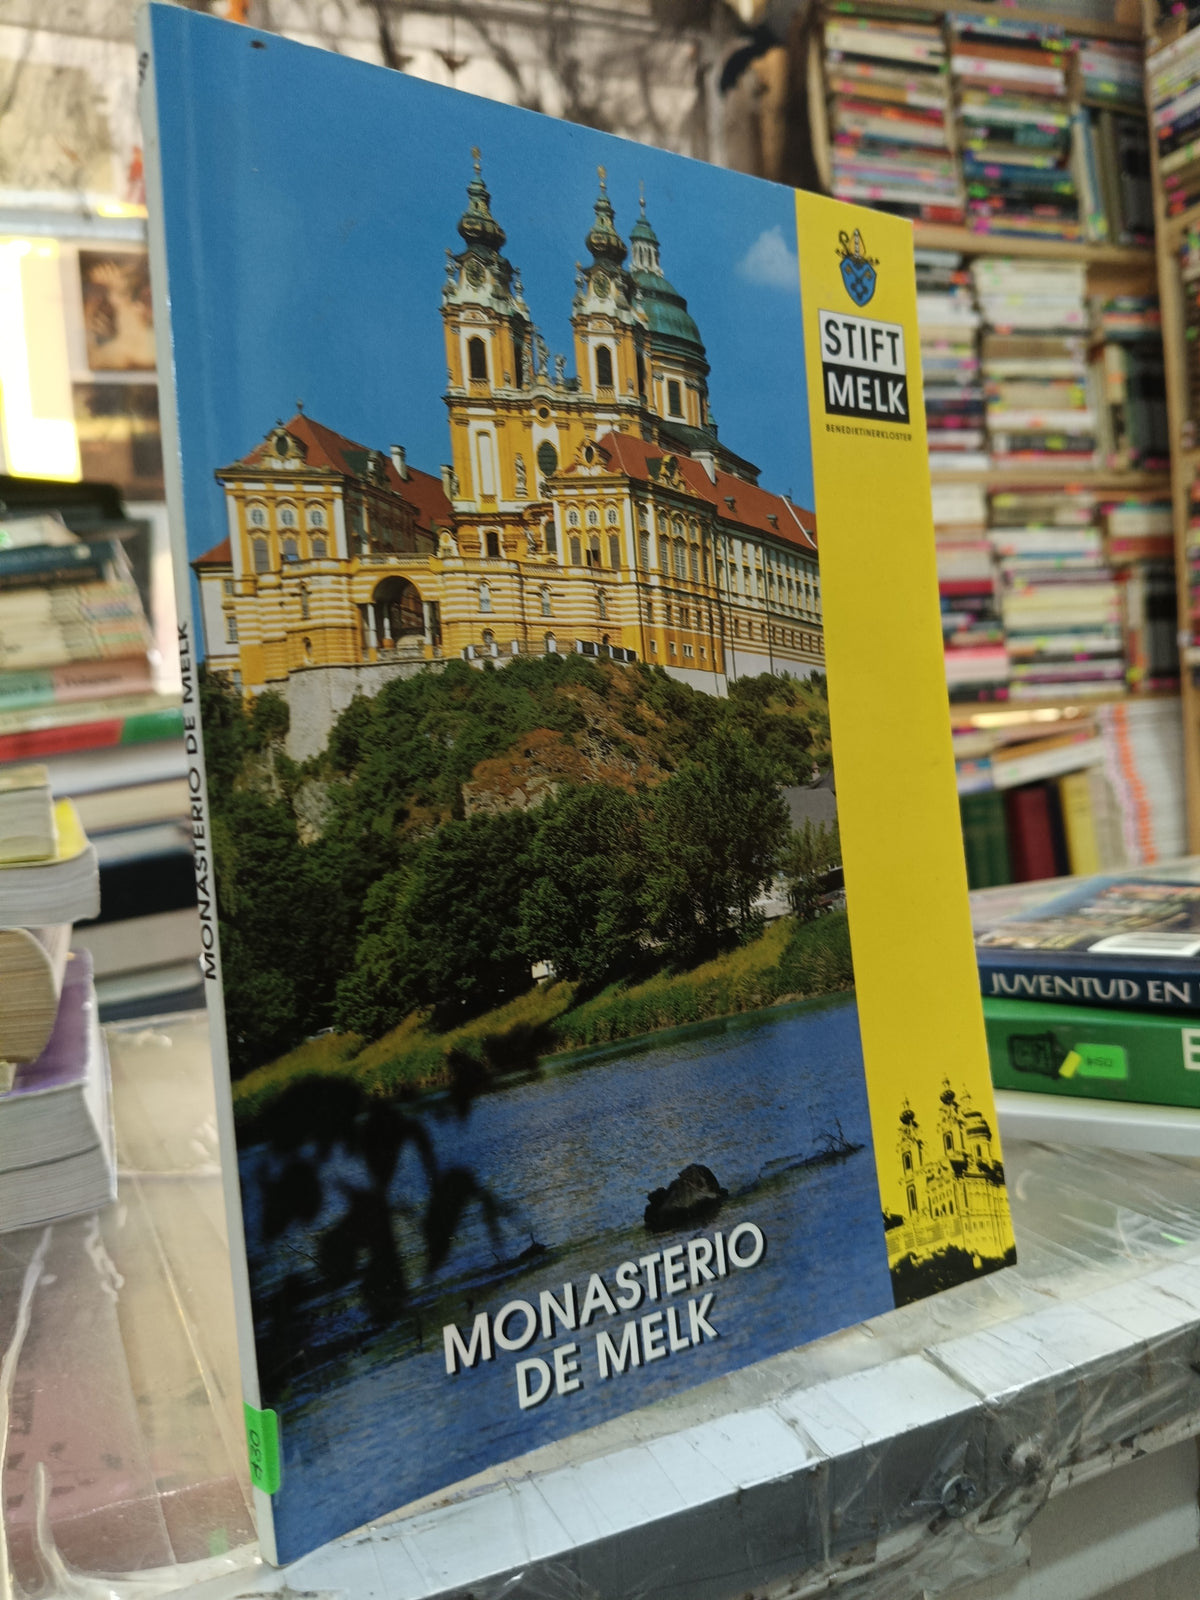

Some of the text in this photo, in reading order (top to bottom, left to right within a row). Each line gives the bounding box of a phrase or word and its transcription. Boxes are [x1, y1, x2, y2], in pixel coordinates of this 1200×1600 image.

[824, 319, 899, 366] STIFT
[827, 371, 906, 415] MELK
[825, 423, 912, 441] BENEDIKTINERKLOSTER
[177, 621, 217, 980] MONASTERIO DE MELK
[990, 972, 1191, 1004] JUVENTUD EN
[443, 1222, 765, 1375] MONASTERIO
[515, 1293, 720, 1410] DE MELK
